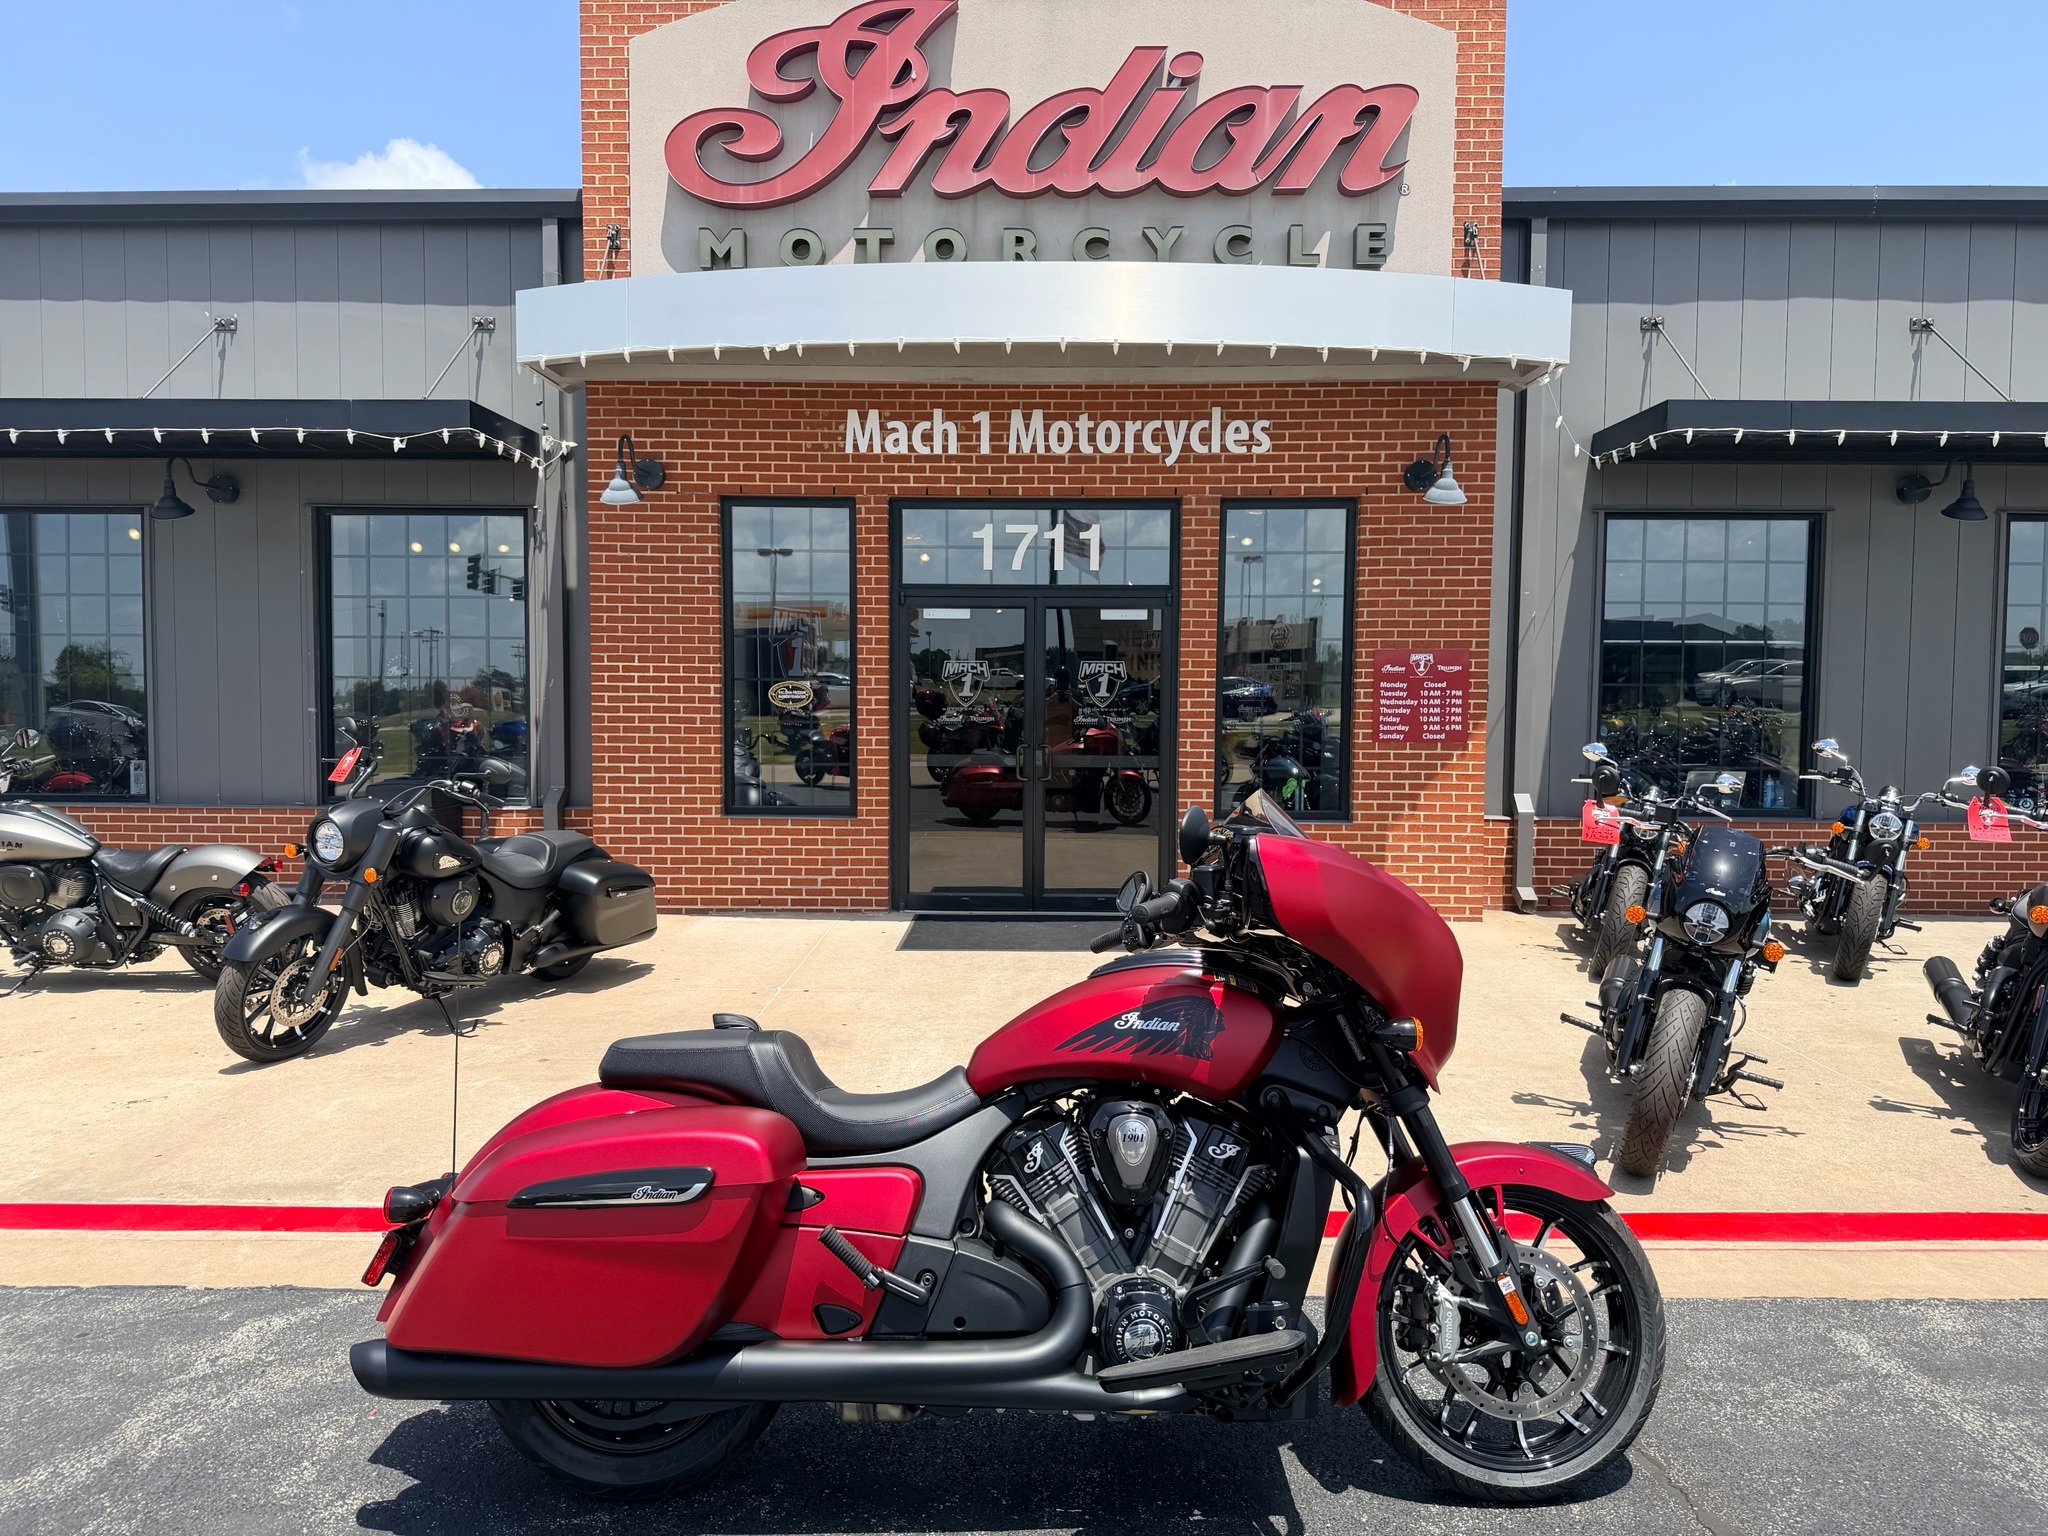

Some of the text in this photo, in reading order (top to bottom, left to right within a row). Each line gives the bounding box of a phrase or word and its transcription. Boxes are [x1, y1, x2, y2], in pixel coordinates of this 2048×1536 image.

[664, 0, 1419, 209] Indian
[698, 222, 1388, 270] MOTORCYCLE
[845, 407, 1271, 467] Mach 1 Motorcycles
[973, 523, 1100, 571] 1711
[945, 662, 988, 677] MACH
[1081, 663, 1124, 677] MACH
[958, 673, 974, 697] 1
[1095, 673, 1110, 697] 1
[1380, 681, 1407, 689] Monday
[0, 841, 23, 849] IAN
[1114, 1011, 1180, 1032] Indian
[1122, 1133, 1144, 1142] 1901
[631, 1185, 679, 1200] Indian
[1115, 1318, 1129, 1360] INDIAN
[1130, 1310, 1173, 1353] MOTORCYCL
[1444, 1311, 1453, 1350] brembo
